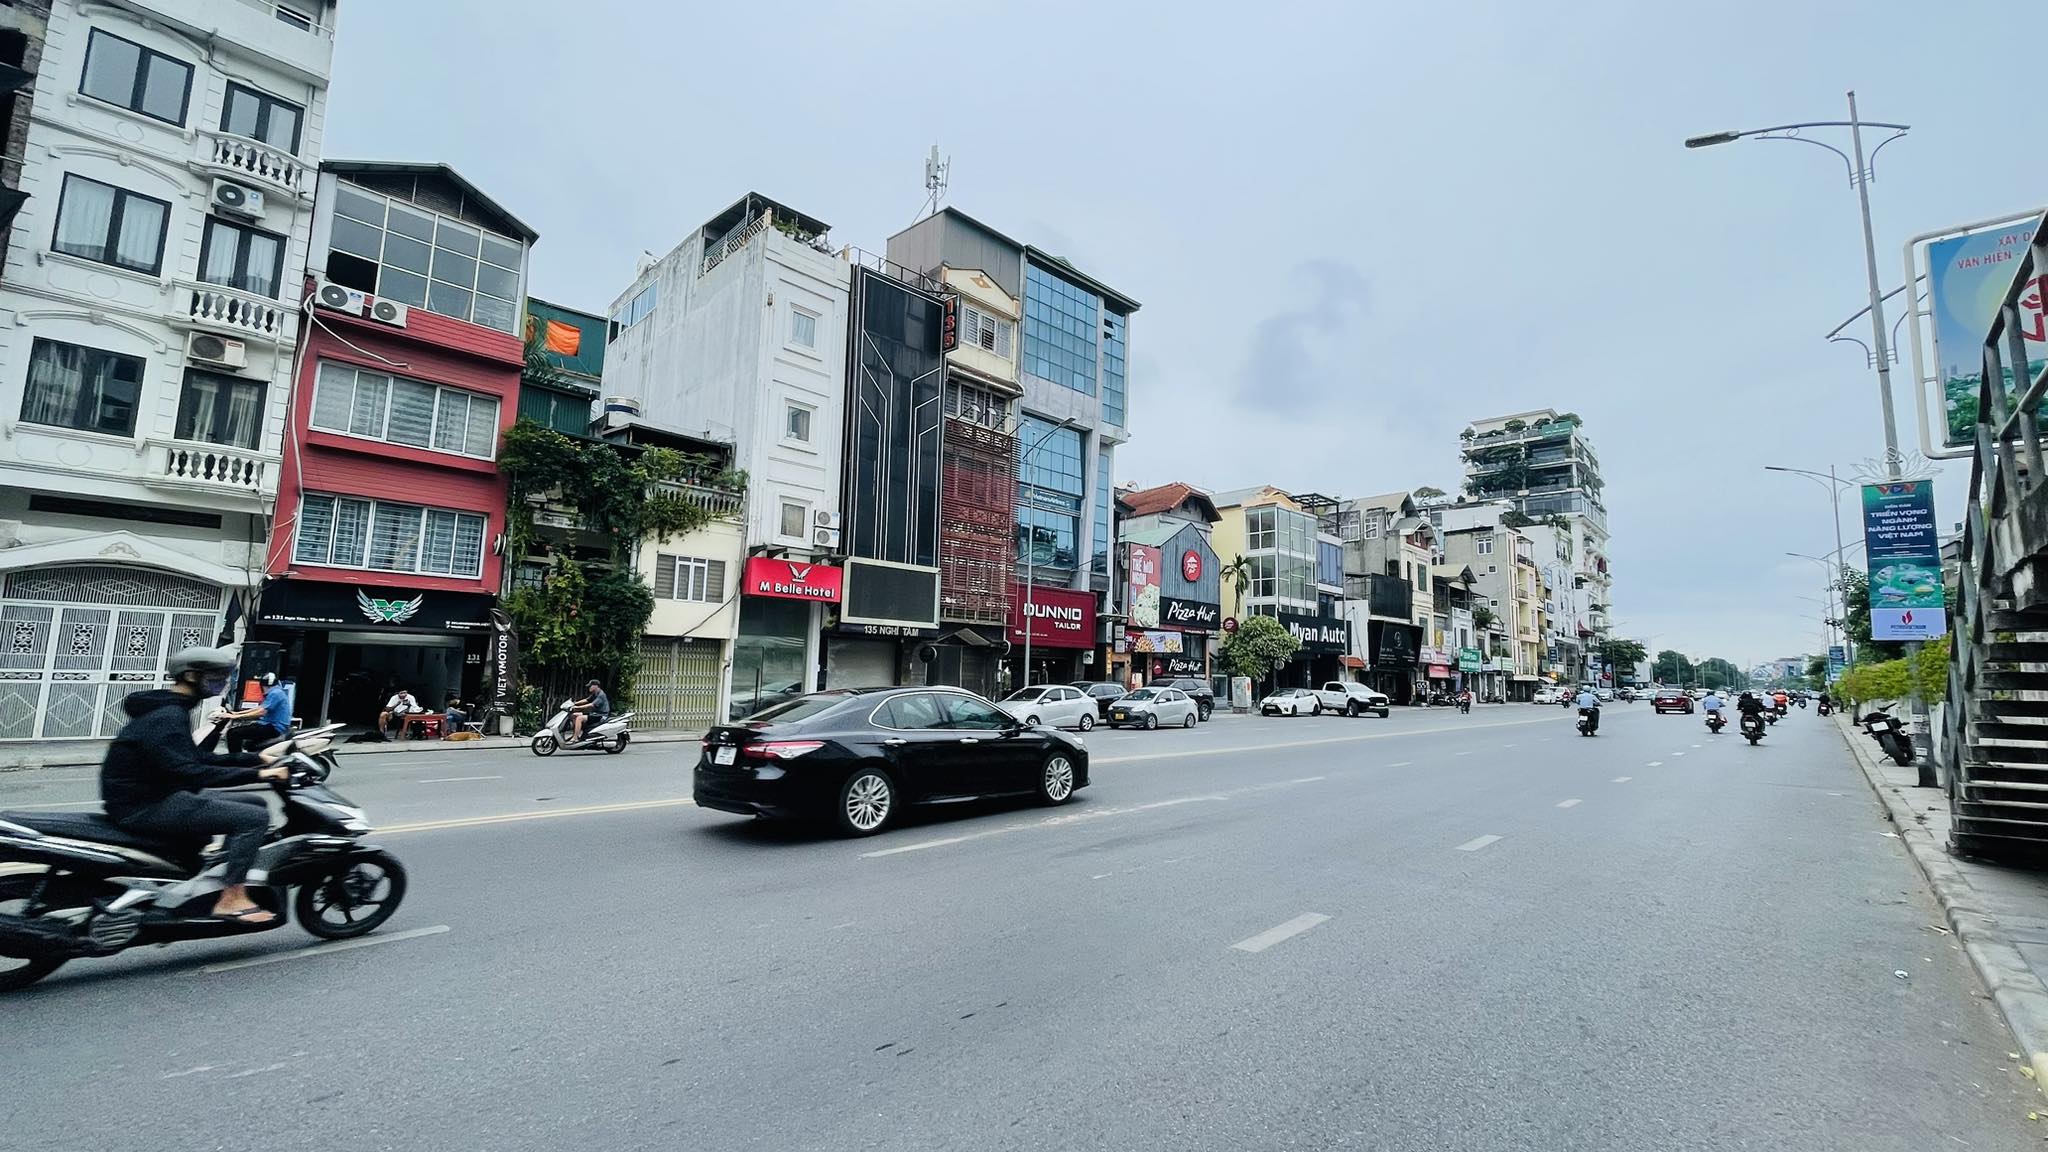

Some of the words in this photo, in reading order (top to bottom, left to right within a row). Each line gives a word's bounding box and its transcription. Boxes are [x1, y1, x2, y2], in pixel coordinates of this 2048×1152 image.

[943, 299, 956, 348] 135
[760, 581, 771, 592] M
[775, 582, 802, 595] Belle
[804, 586, 836, 598] Hotel
[1023, 603, 1082, 620] DUNNIO
[1167, 601, 1196, 621] Pizza
[1196, 605, 1217, 622] Hut
[864, 625, 878, 634] 135
[1054, 621, 1081, 630] TAILOR
[1289, 621, 1319, 644] Myan
[1320, 625, 1345, 644] Auto
[1168, 659, 1188, 672] Pizza
[1187, 661, 1203, 672] Hut
[496, 676, 507, 698] VIET
